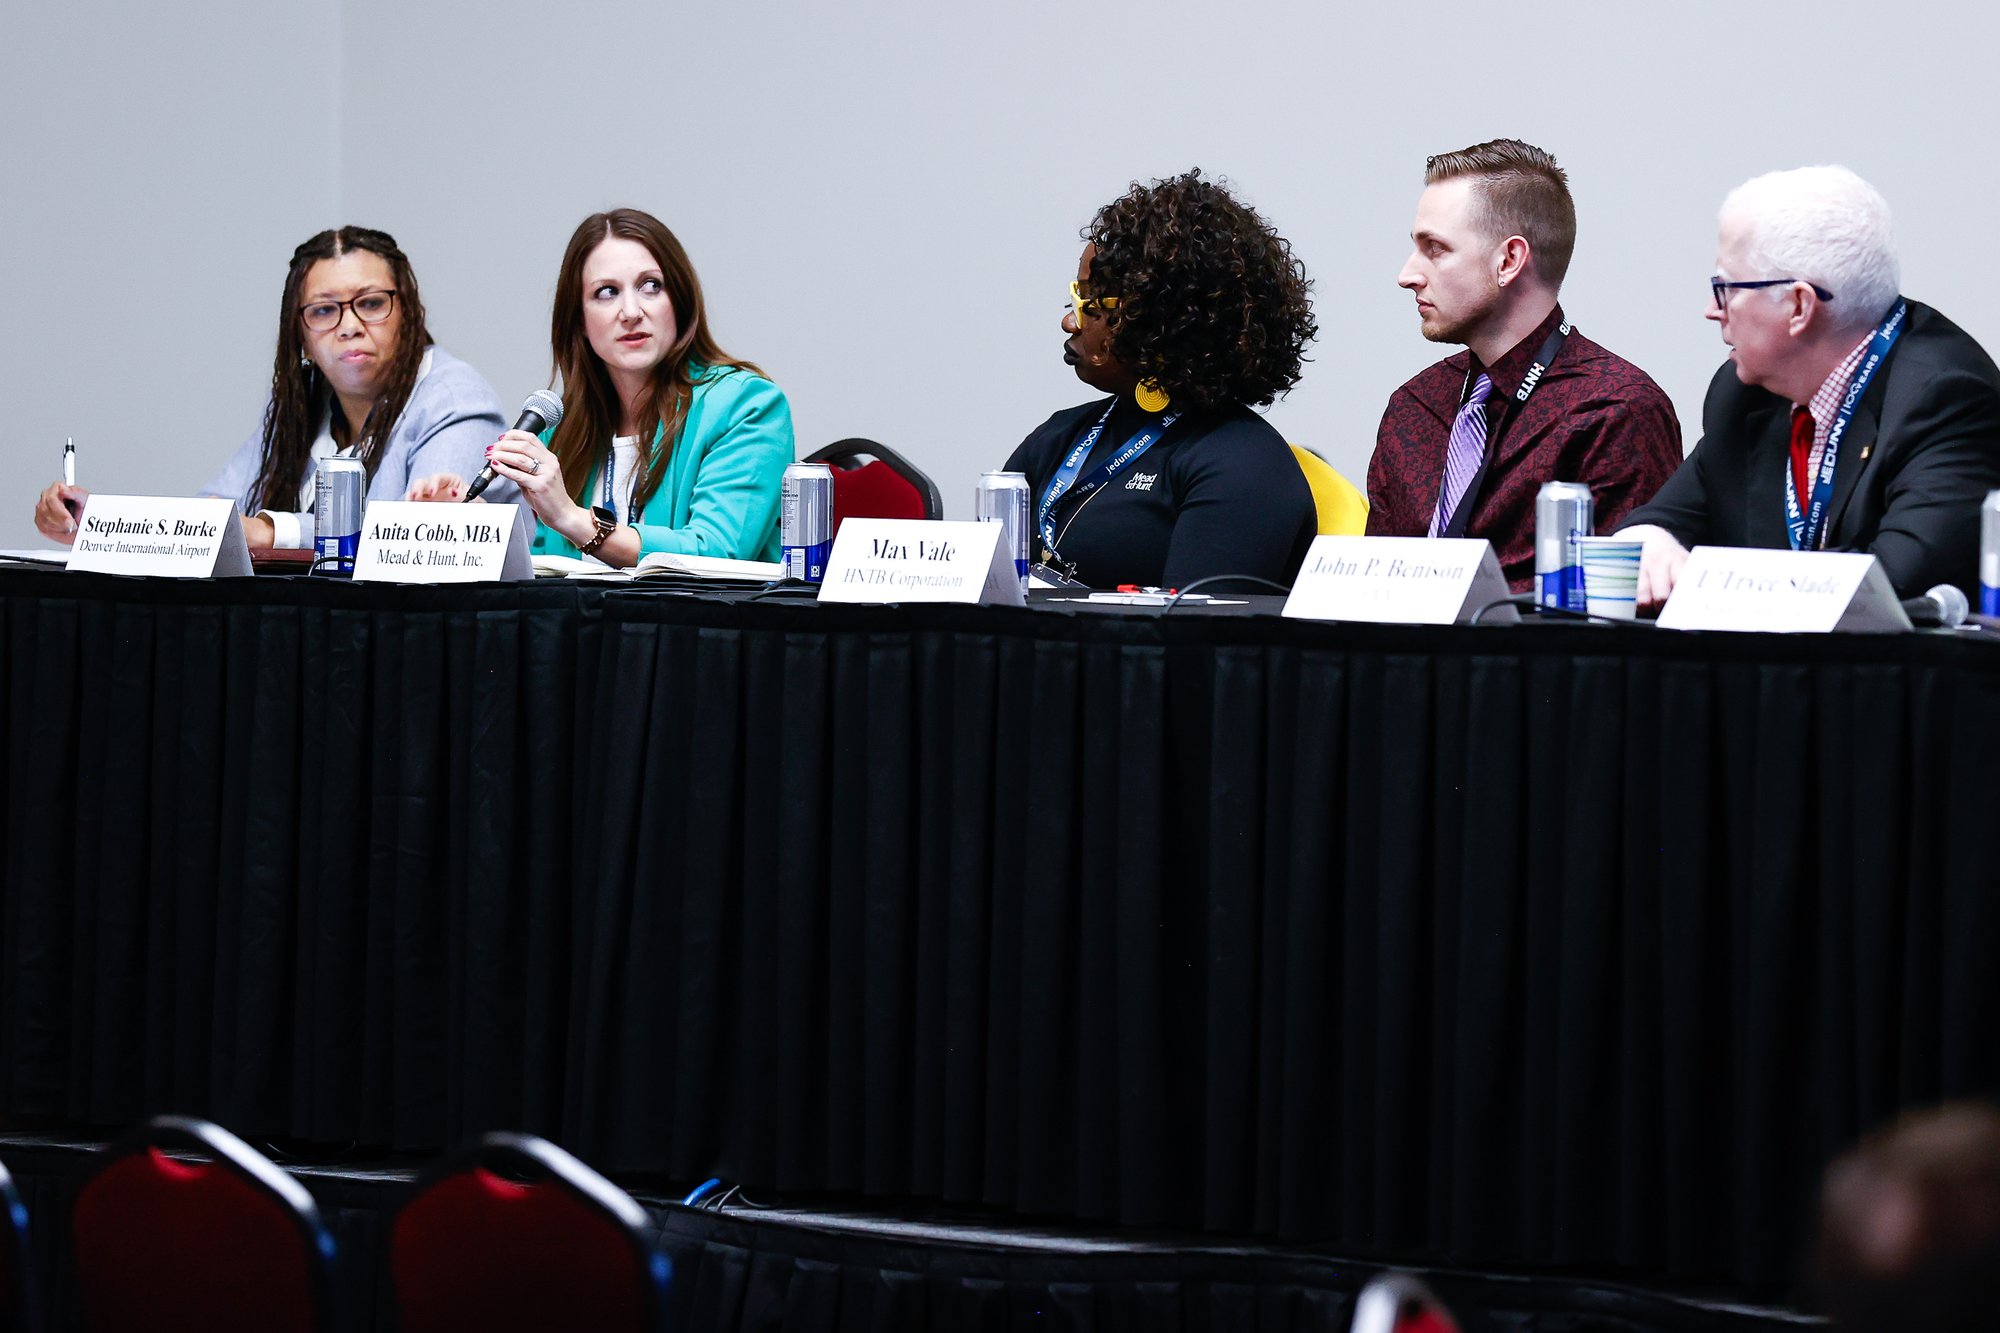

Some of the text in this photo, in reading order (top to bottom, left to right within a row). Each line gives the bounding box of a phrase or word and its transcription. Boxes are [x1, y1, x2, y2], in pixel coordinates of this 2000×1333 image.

[1516, 362, 1546, 401] HNTB
[1105, 434, 1152, 476] jedunn.com
[1820, 417, 1847, 485] JEDUNN
[1132, 472, 1158, 483] Mead
[1040, 478, 1066, 521] jedunn.co
[85, 515, 217, 538] Stephanie S. Burke
[369, 522, 501, 543] Anita Cobb, MBA
[79, 539, 211, 560] Denver International Airport
[377, 549, 409, 565] Mead
[412, 549, 424, 566] &
[462, 551, 484, 567] Inc.
[867, 538, 956, 562] Max Vale
[843, 568, 963, 590] HNTB Corporation
[1309, 556, 1464, 580] John P. Benison
